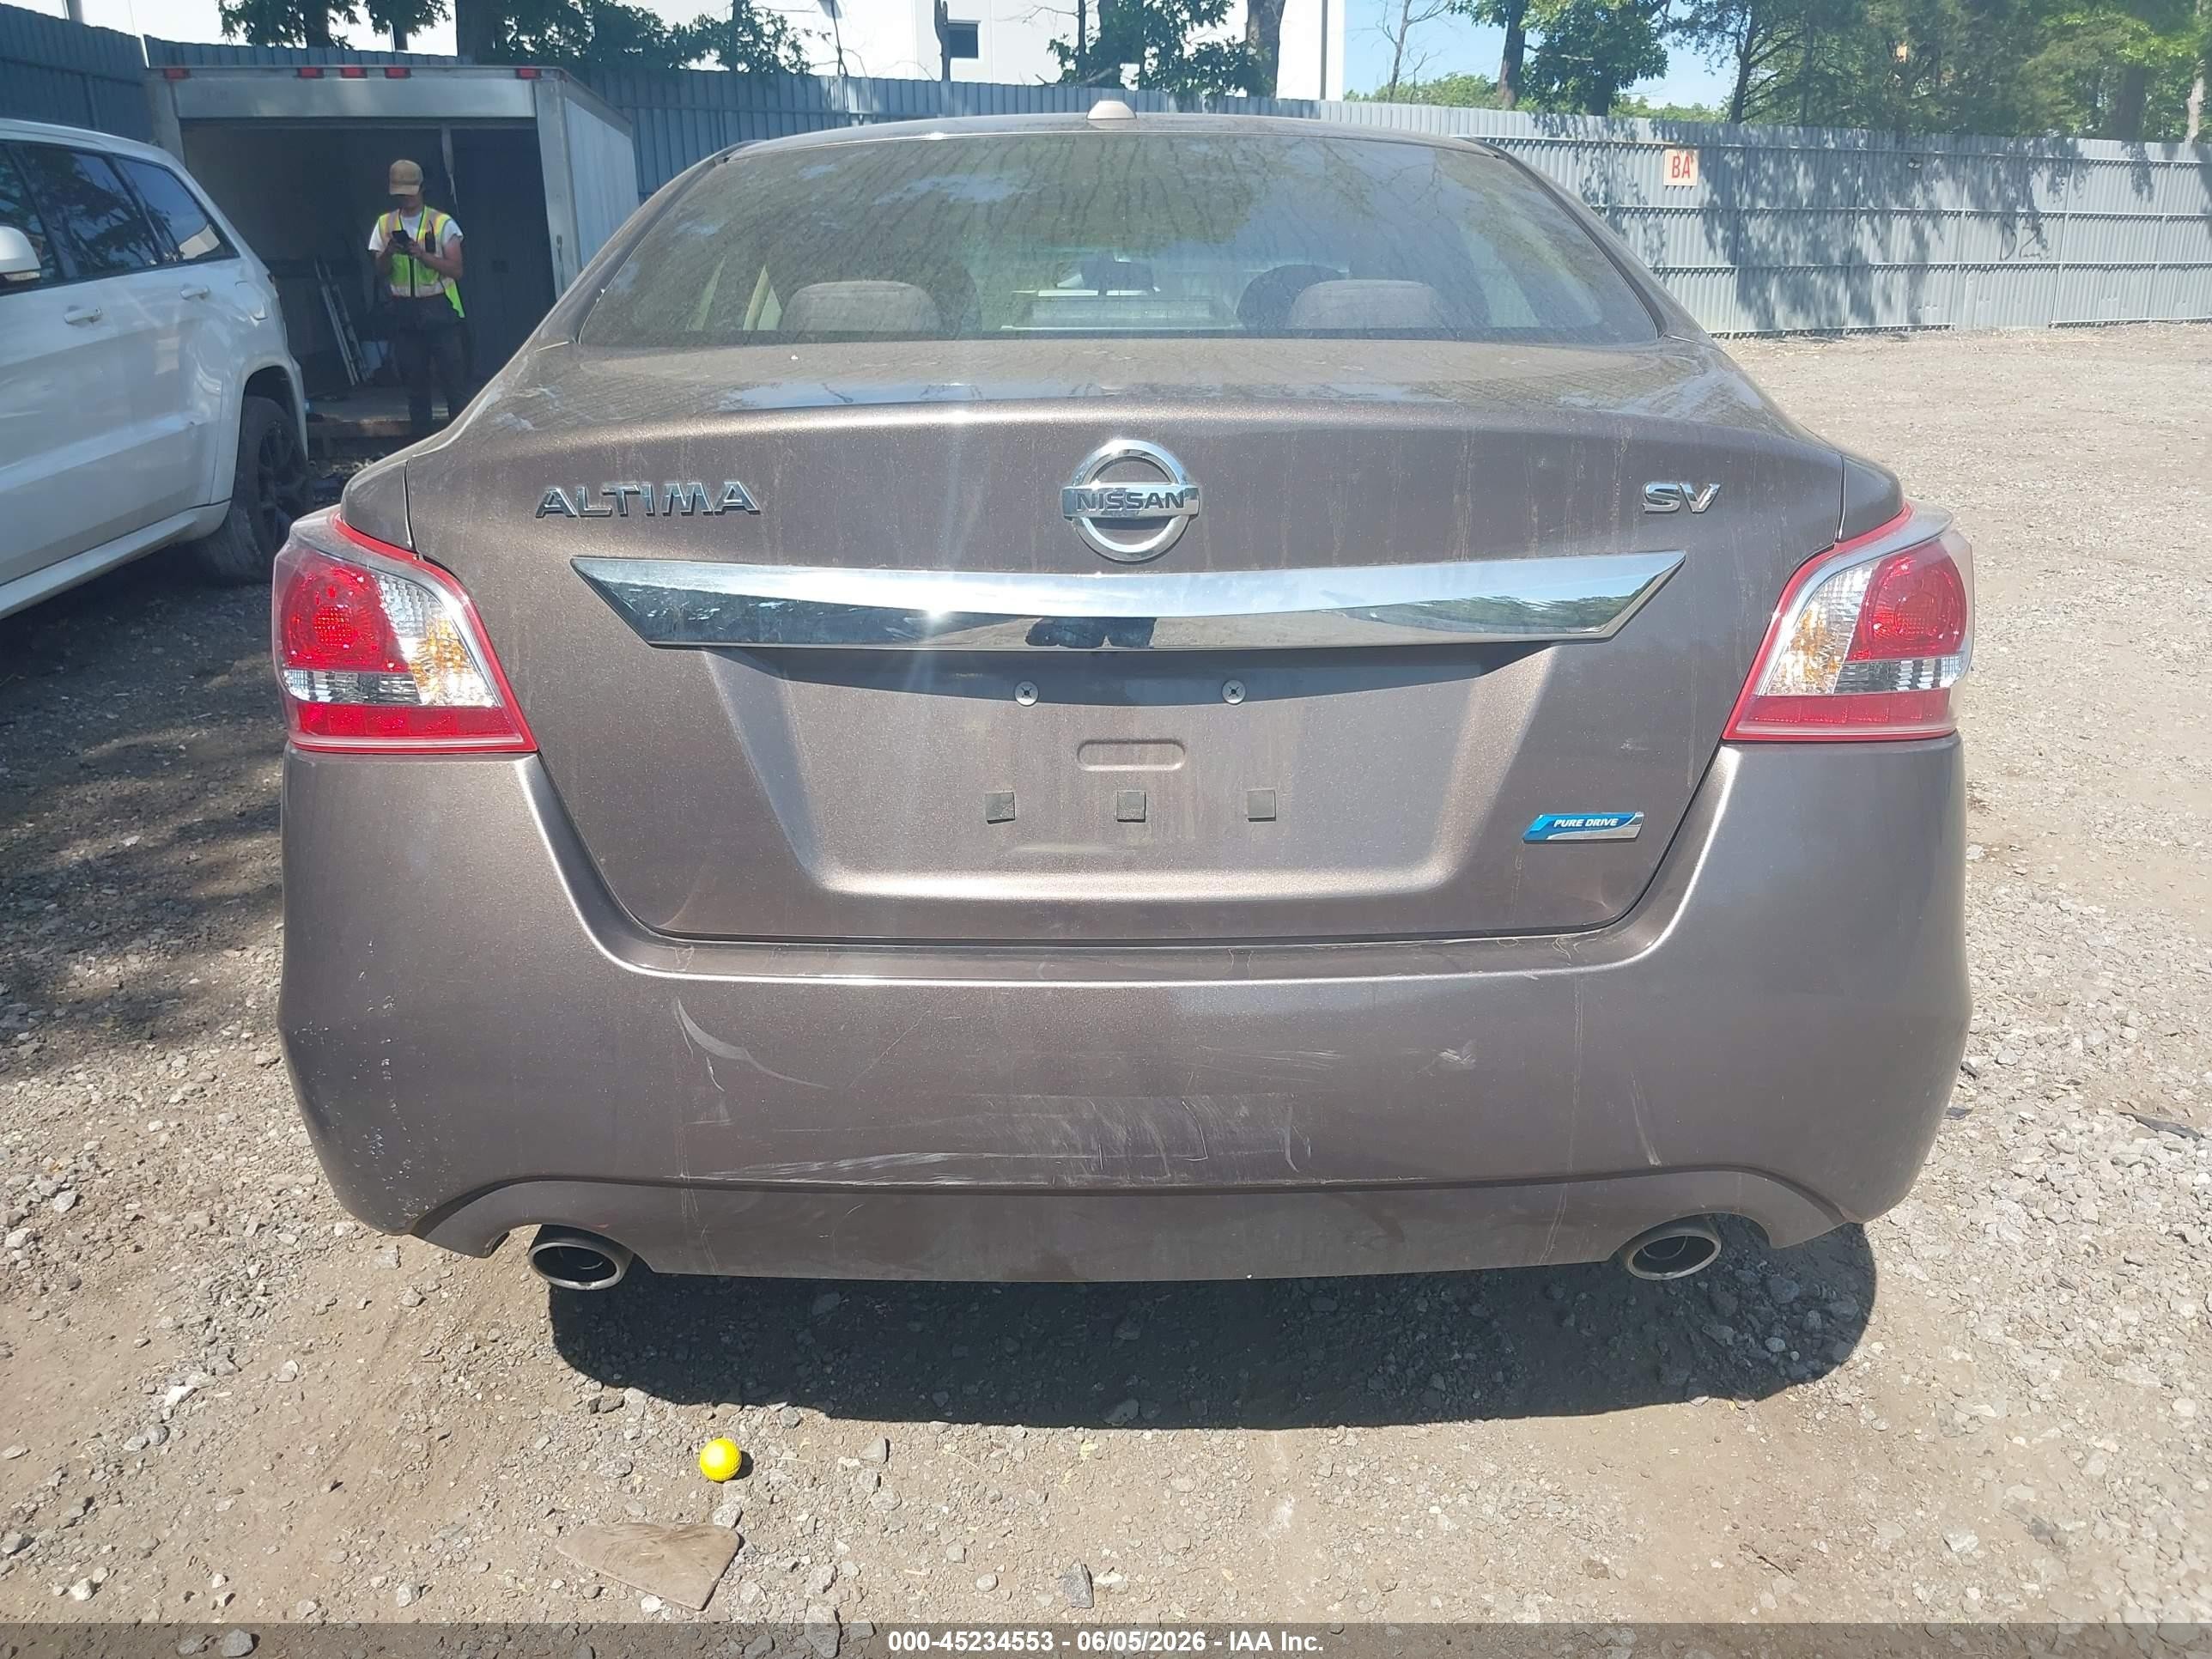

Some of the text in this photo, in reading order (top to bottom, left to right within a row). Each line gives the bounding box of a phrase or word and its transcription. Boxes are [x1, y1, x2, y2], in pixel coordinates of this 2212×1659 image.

[1672, 155, 1691, 179] BA
[536, 481, 761, 519] ALTIMA
[1076, 492, 1185, 511] NISSAN
[1642, 482, 1721, 515] SV
[1553, 817, 1619, 828] PURE DRIVE
